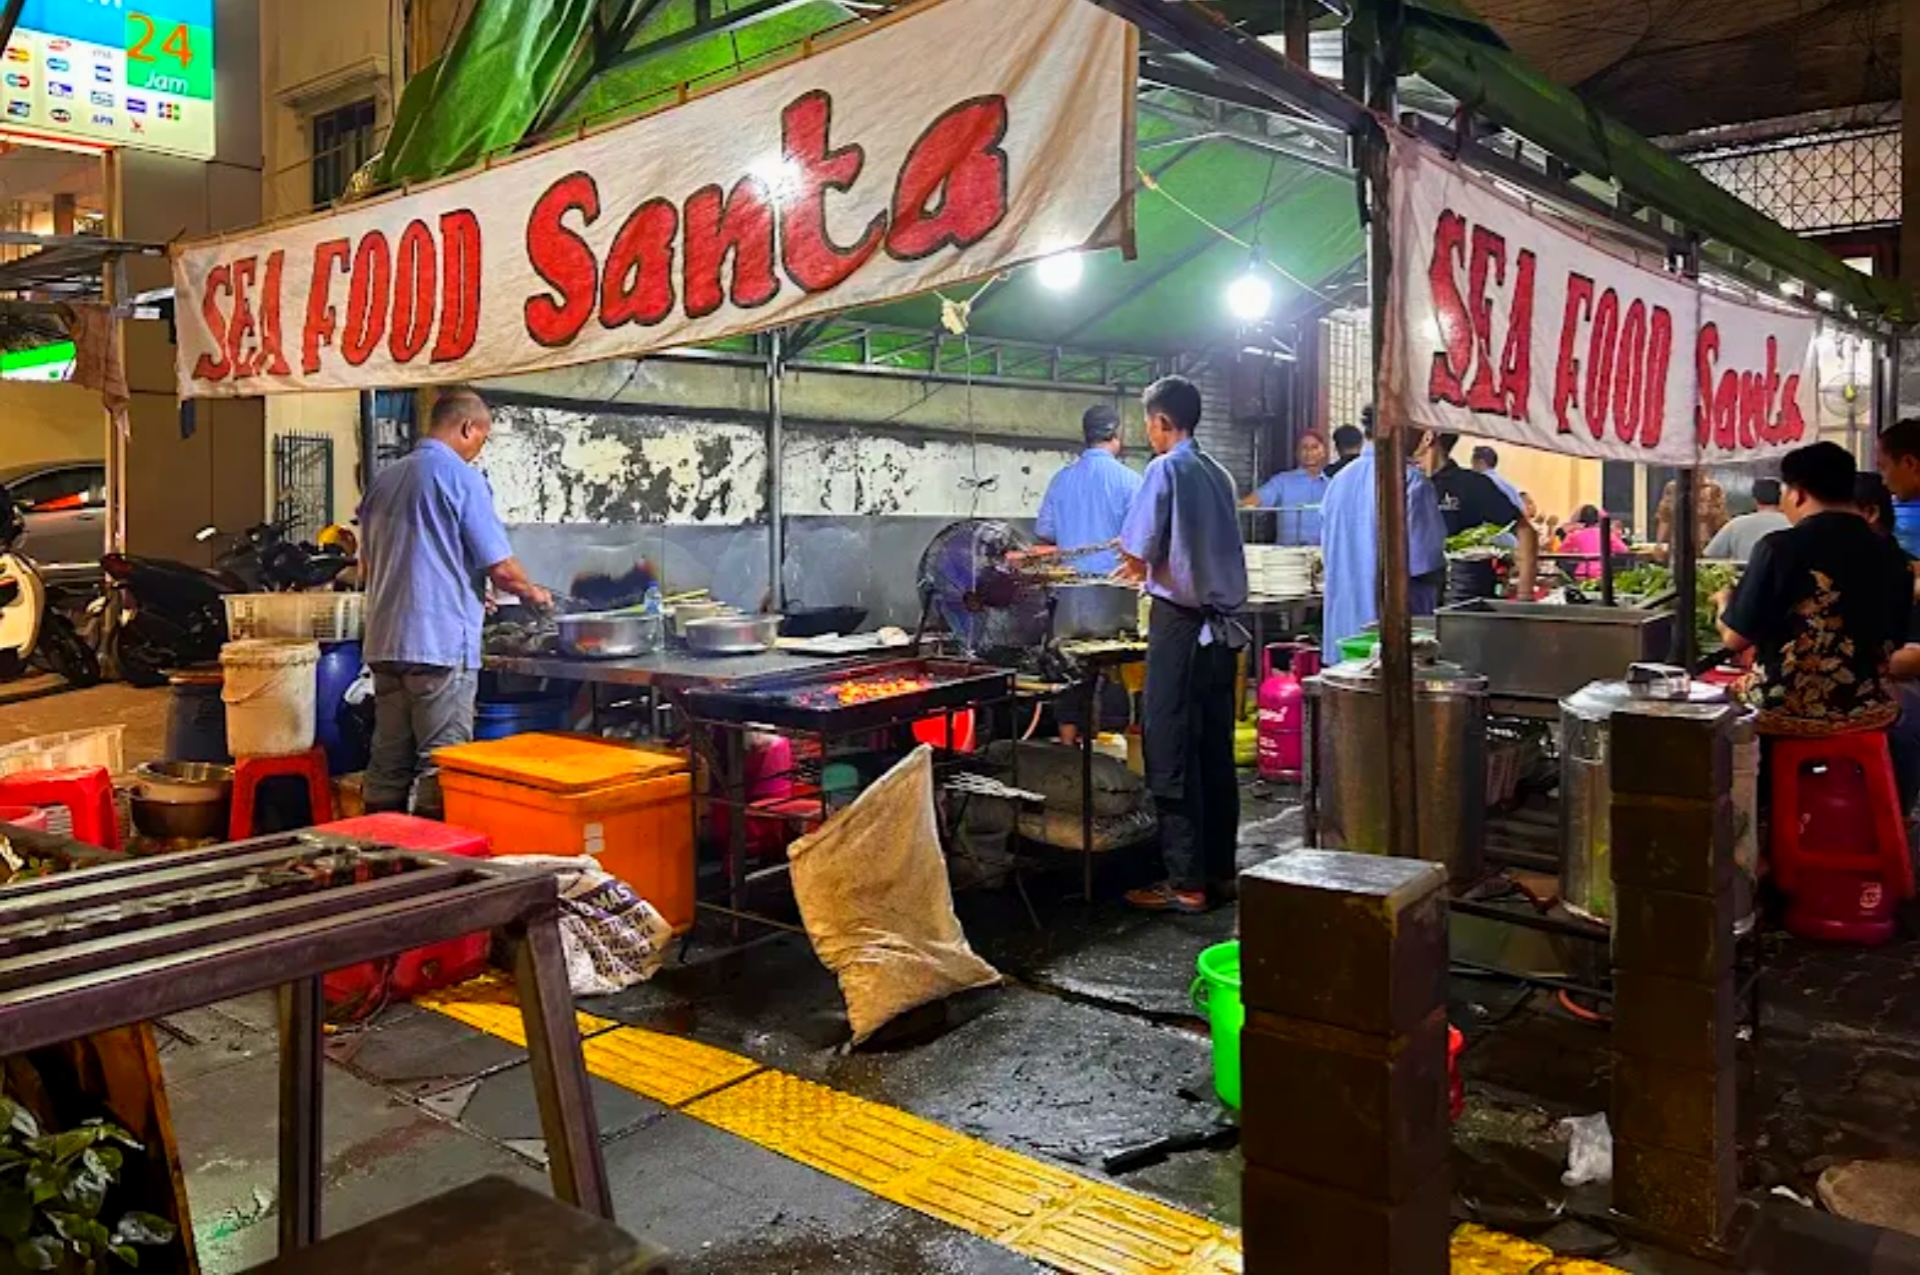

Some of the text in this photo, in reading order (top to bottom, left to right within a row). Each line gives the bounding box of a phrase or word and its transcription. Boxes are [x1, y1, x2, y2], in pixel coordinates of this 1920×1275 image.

[127, 13, 193, 69] 24
[145, 72, 188, 95] Jam
[196, 87, 1010, 383] SEA FOOD Santa
[1427, 207, 1806, 452] SEA FOOD Santa
